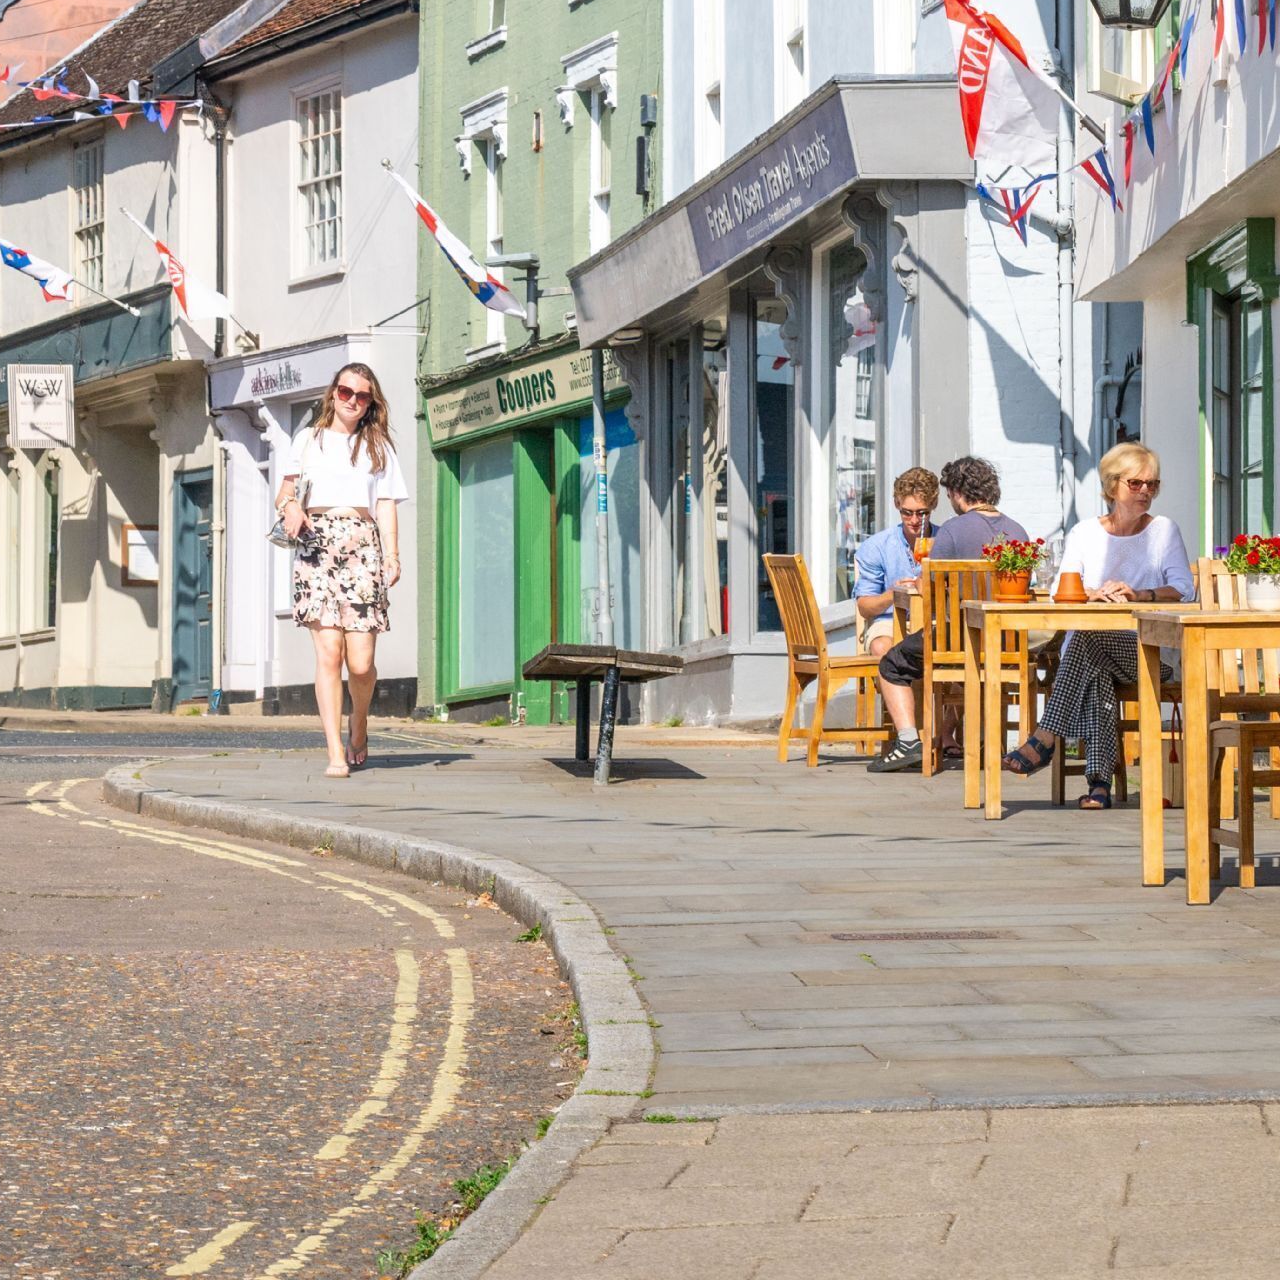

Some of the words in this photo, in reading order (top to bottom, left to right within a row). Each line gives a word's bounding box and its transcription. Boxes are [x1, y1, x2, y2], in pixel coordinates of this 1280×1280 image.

[704, 192, 736, 241] Fred.
[731, 181, 765, 225] Olsen
[759, 148, 795, 204] Travel
[792, 130, 830, 189] Agents
[496, 368, 557, 414] Coopers
